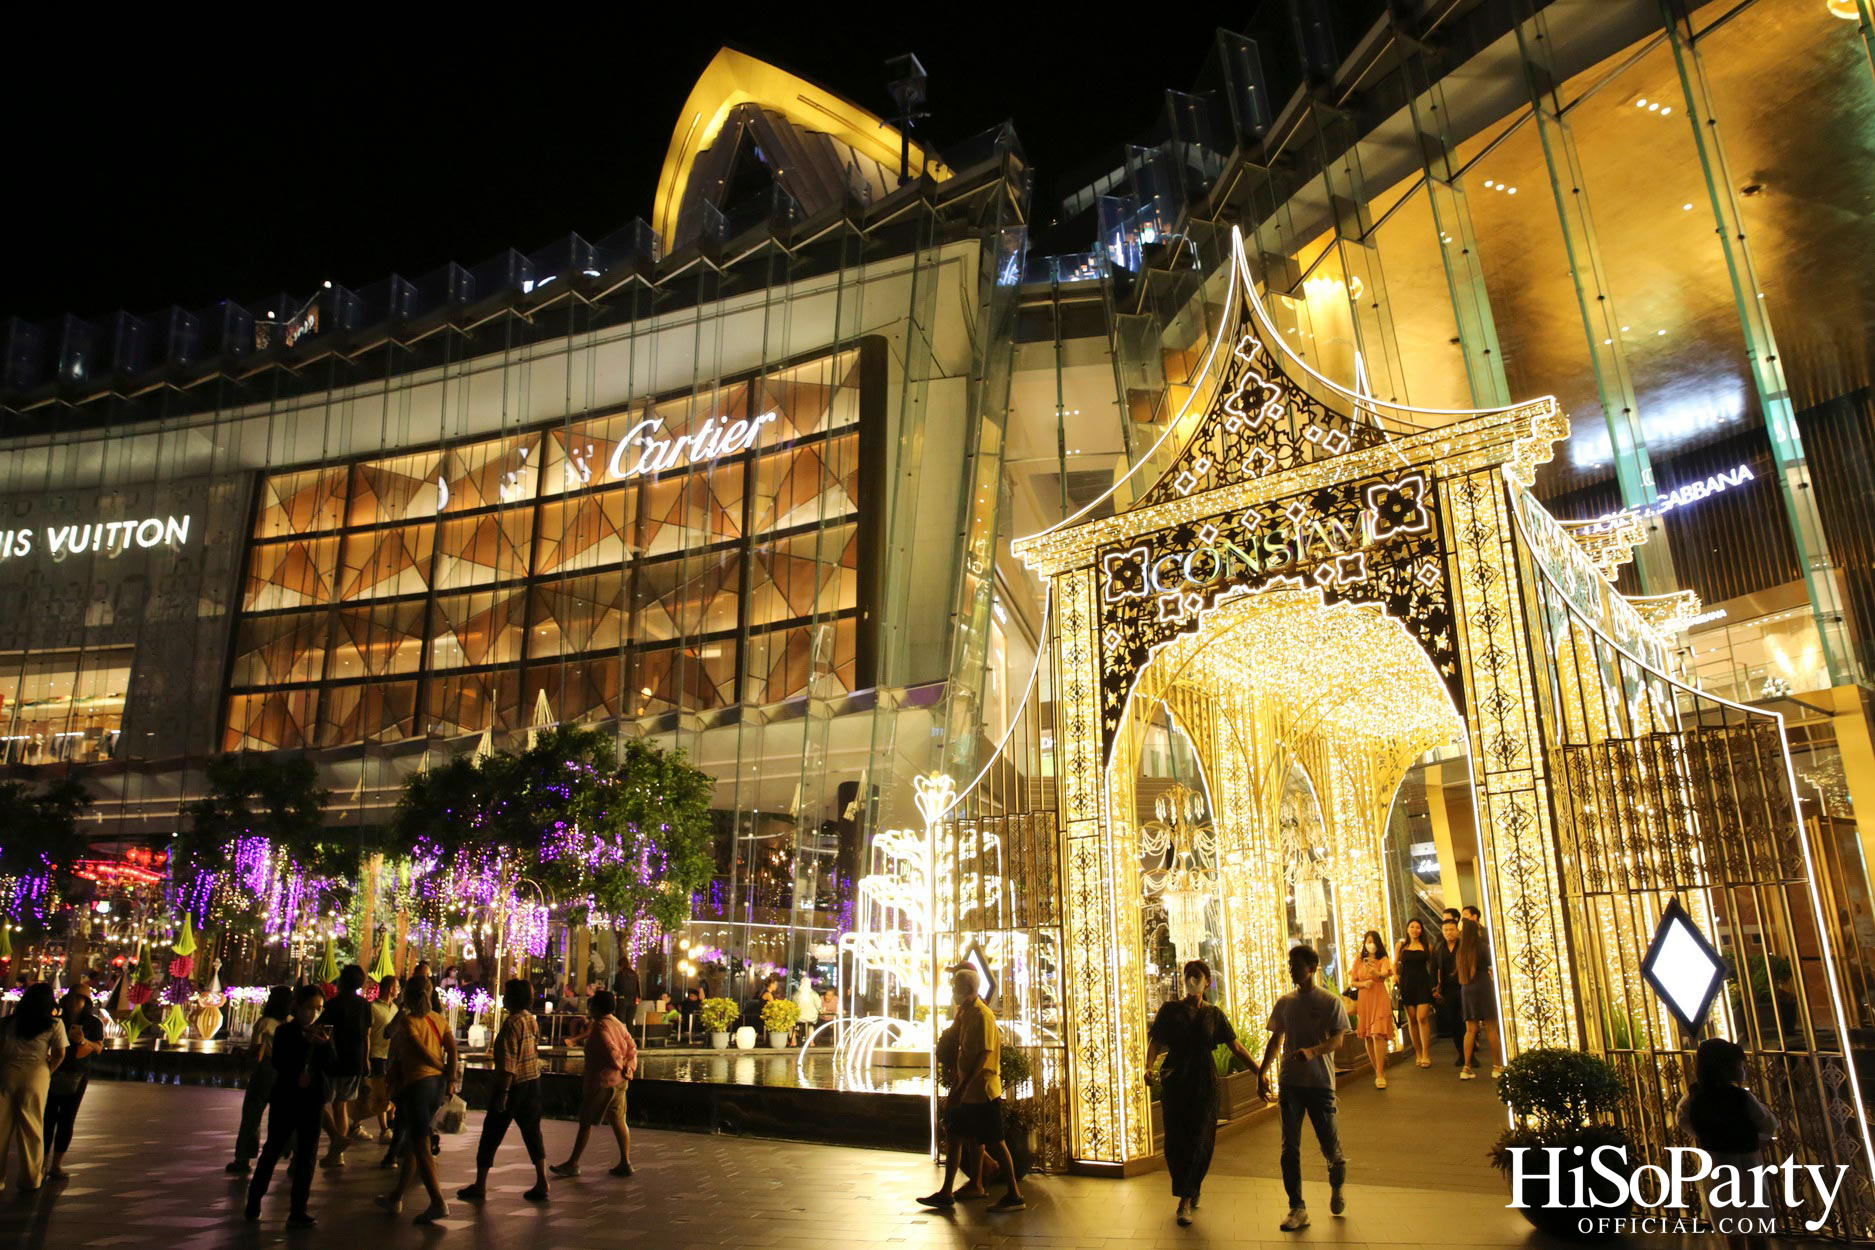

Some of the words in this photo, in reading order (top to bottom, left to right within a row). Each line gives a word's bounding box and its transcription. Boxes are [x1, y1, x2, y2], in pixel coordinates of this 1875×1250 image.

[610, 412, 776, 479] Cartier
[0, 528, 33, 557] IS
[47, 515, 190, 555] VUITTON
